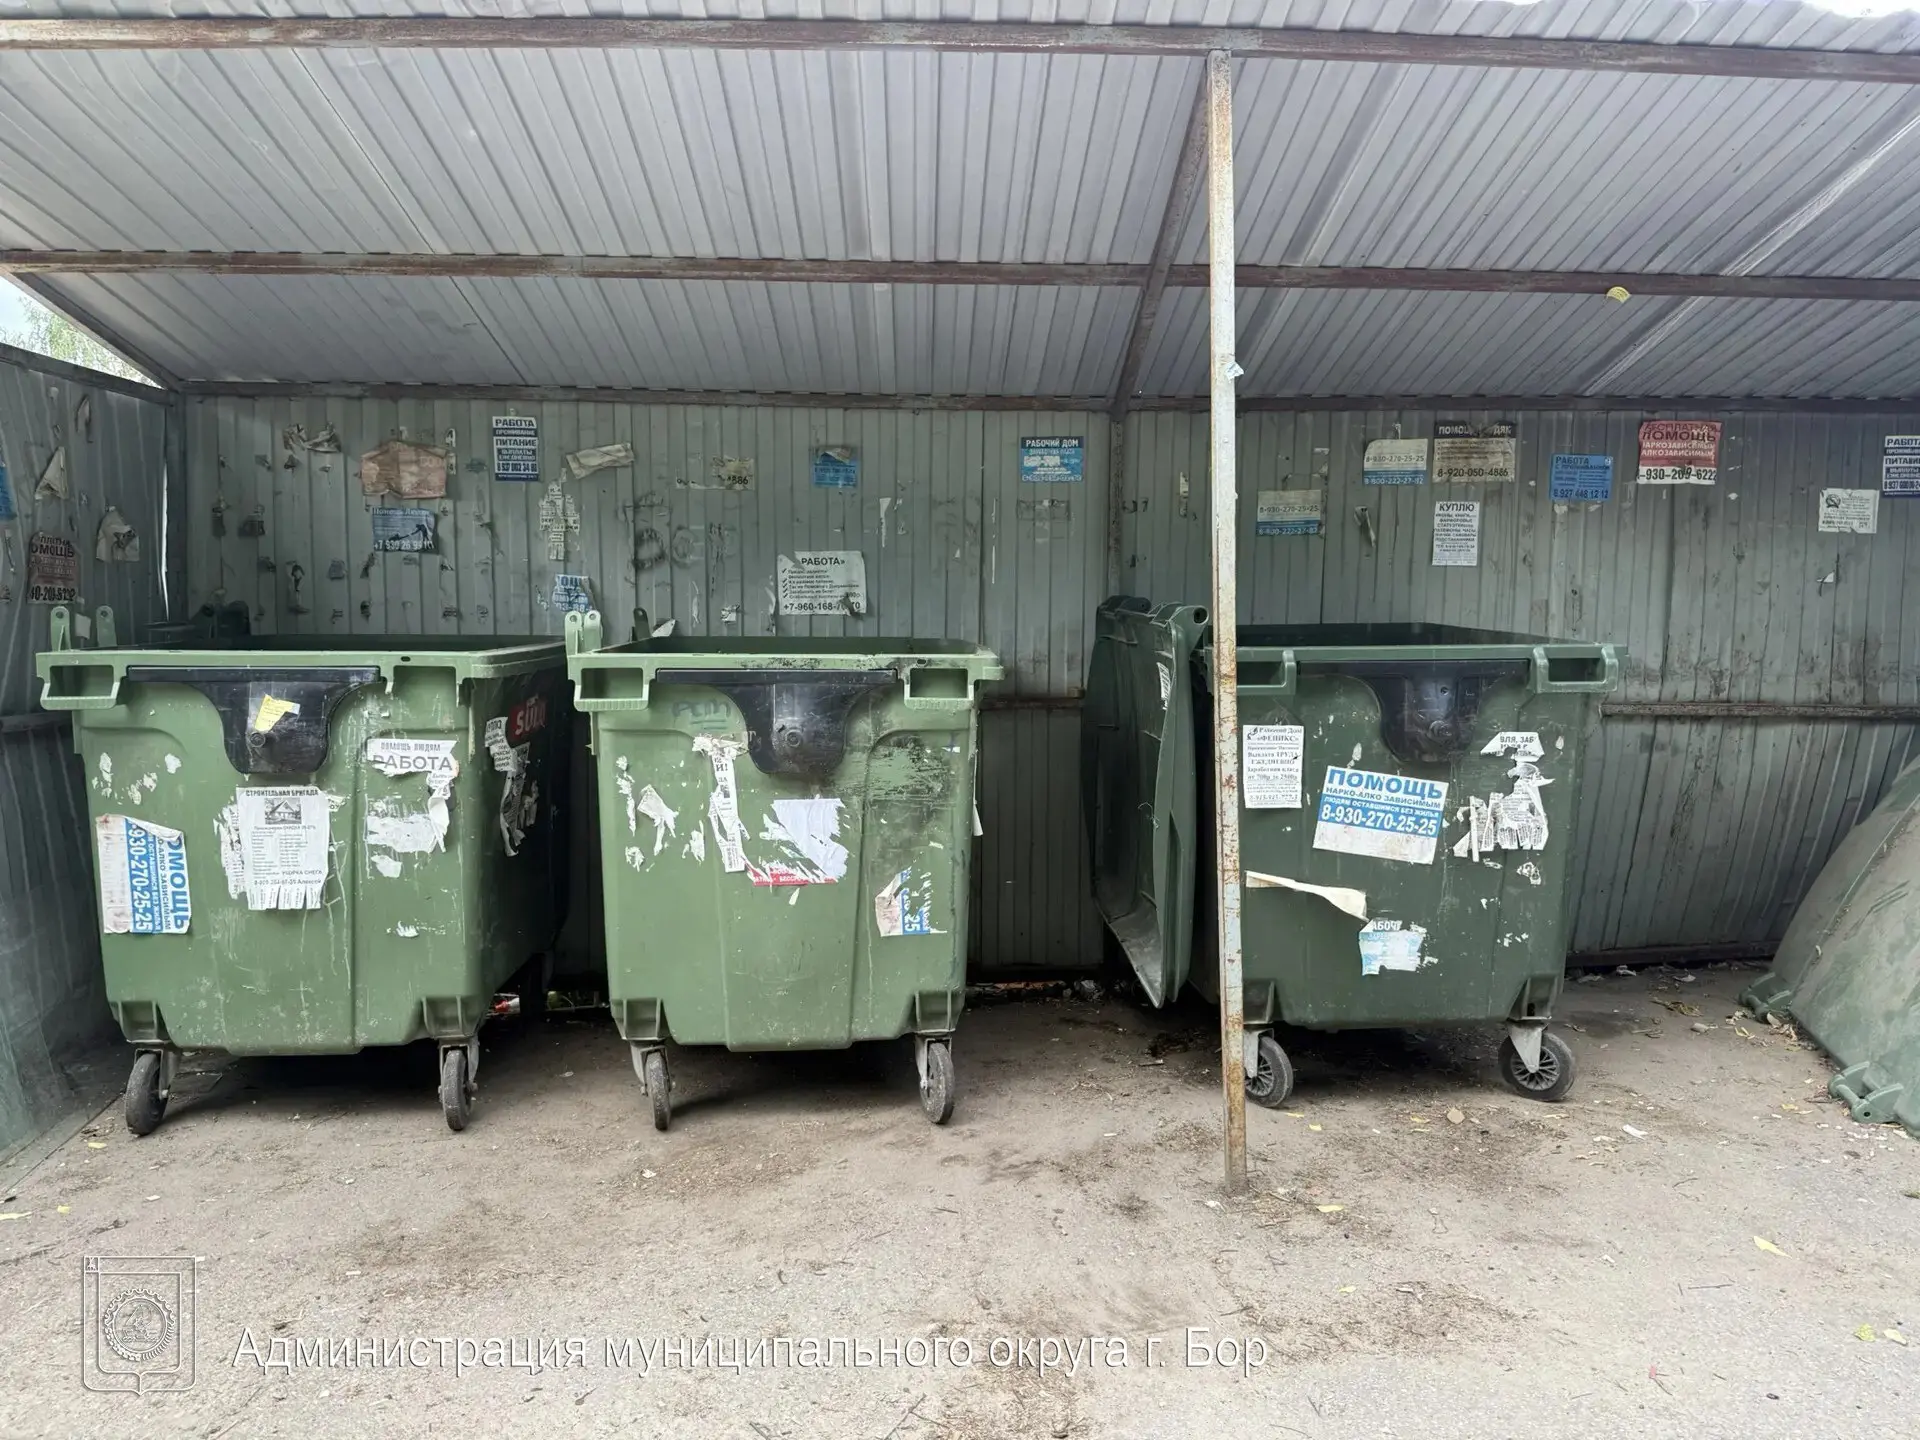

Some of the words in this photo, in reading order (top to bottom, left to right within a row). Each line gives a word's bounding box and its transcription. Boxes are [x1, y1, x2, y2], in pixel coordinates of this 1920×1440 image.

[1026, 438, 1060, 447] РАБОЧИЙ
[1062, 439, 1078, 447] ДОМ
[1642, 431, 1716, 442] ПОМОЩЬ
[1888, 438, 1920, 446] РАБОТ
[1556, 456, 1588, 464] РАБОТА
[1438, 467, 1508, 477] 8-920-050-4886
[381, 742, 410, 751] ПОМОЩЬ
[414, 743, 441, 752] ЛЮДЯМ
[373, 755, 453, 771] РАБОТА
[1328, 769, 1442, 800] ПОМОЩЬ
[1324, 796, 1350, 806] ЛЮДЯМ
[1352, 800, 1399, 812] ОСТАВШИМСЯ
[1401, 807, 1413, 815] БЕЗ
[1414, 809, 1439, 817] ЖИЛЬЯ
[1326, 787, 1382, 800] НАРКО-АЛКО
[1384, 796, 1441, 809] ЗАВИСИМЫМ
[1322, 804, 1437, 835] 8-930-270-25-25
[128, 824, 152, 930] -930-270-25-25
[167, 836, 189, 929] ОМОЩЬ
[160, 873, 171, 930] ЗАВИСИМЫМ
